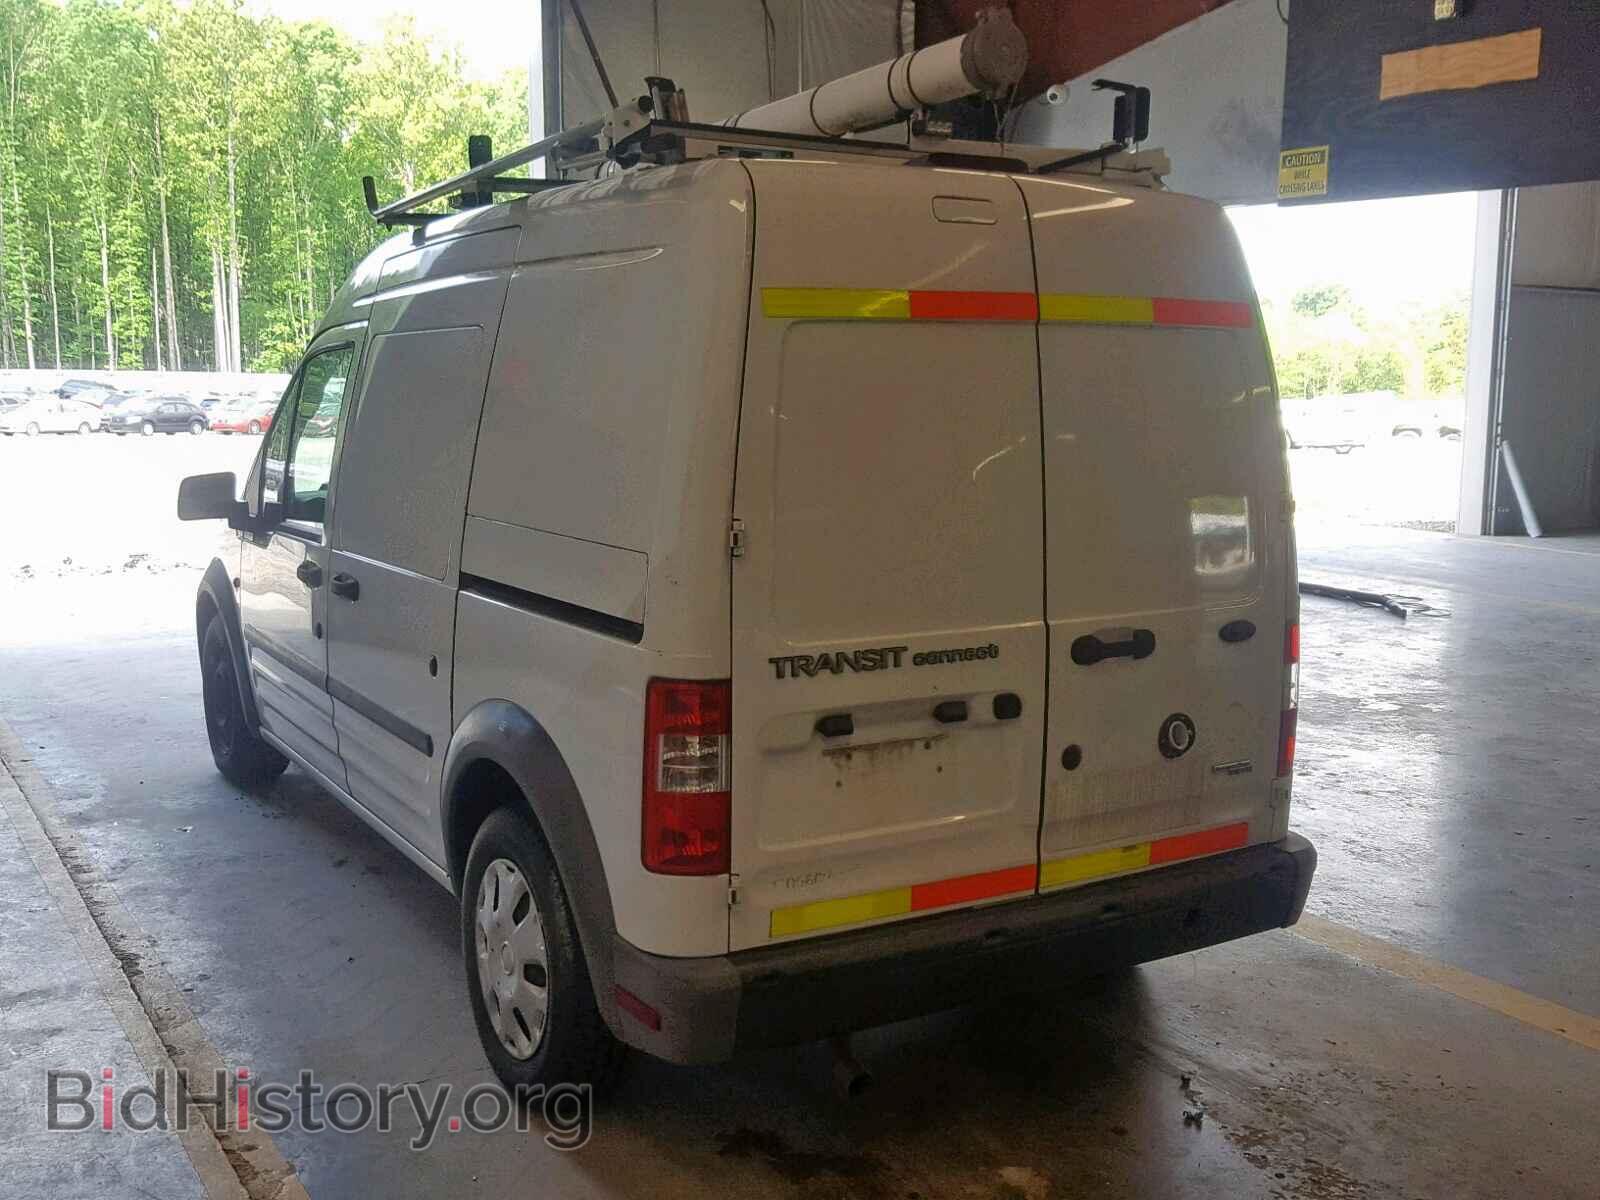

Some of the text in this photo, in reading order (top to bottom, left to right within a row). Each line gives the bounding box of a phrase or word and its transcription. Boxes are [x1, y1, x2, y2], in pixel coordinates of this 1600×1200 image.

[1285, 152, 1321, 167] CAUTION
[768, 643, 1000, 680] TRANSIT connect
